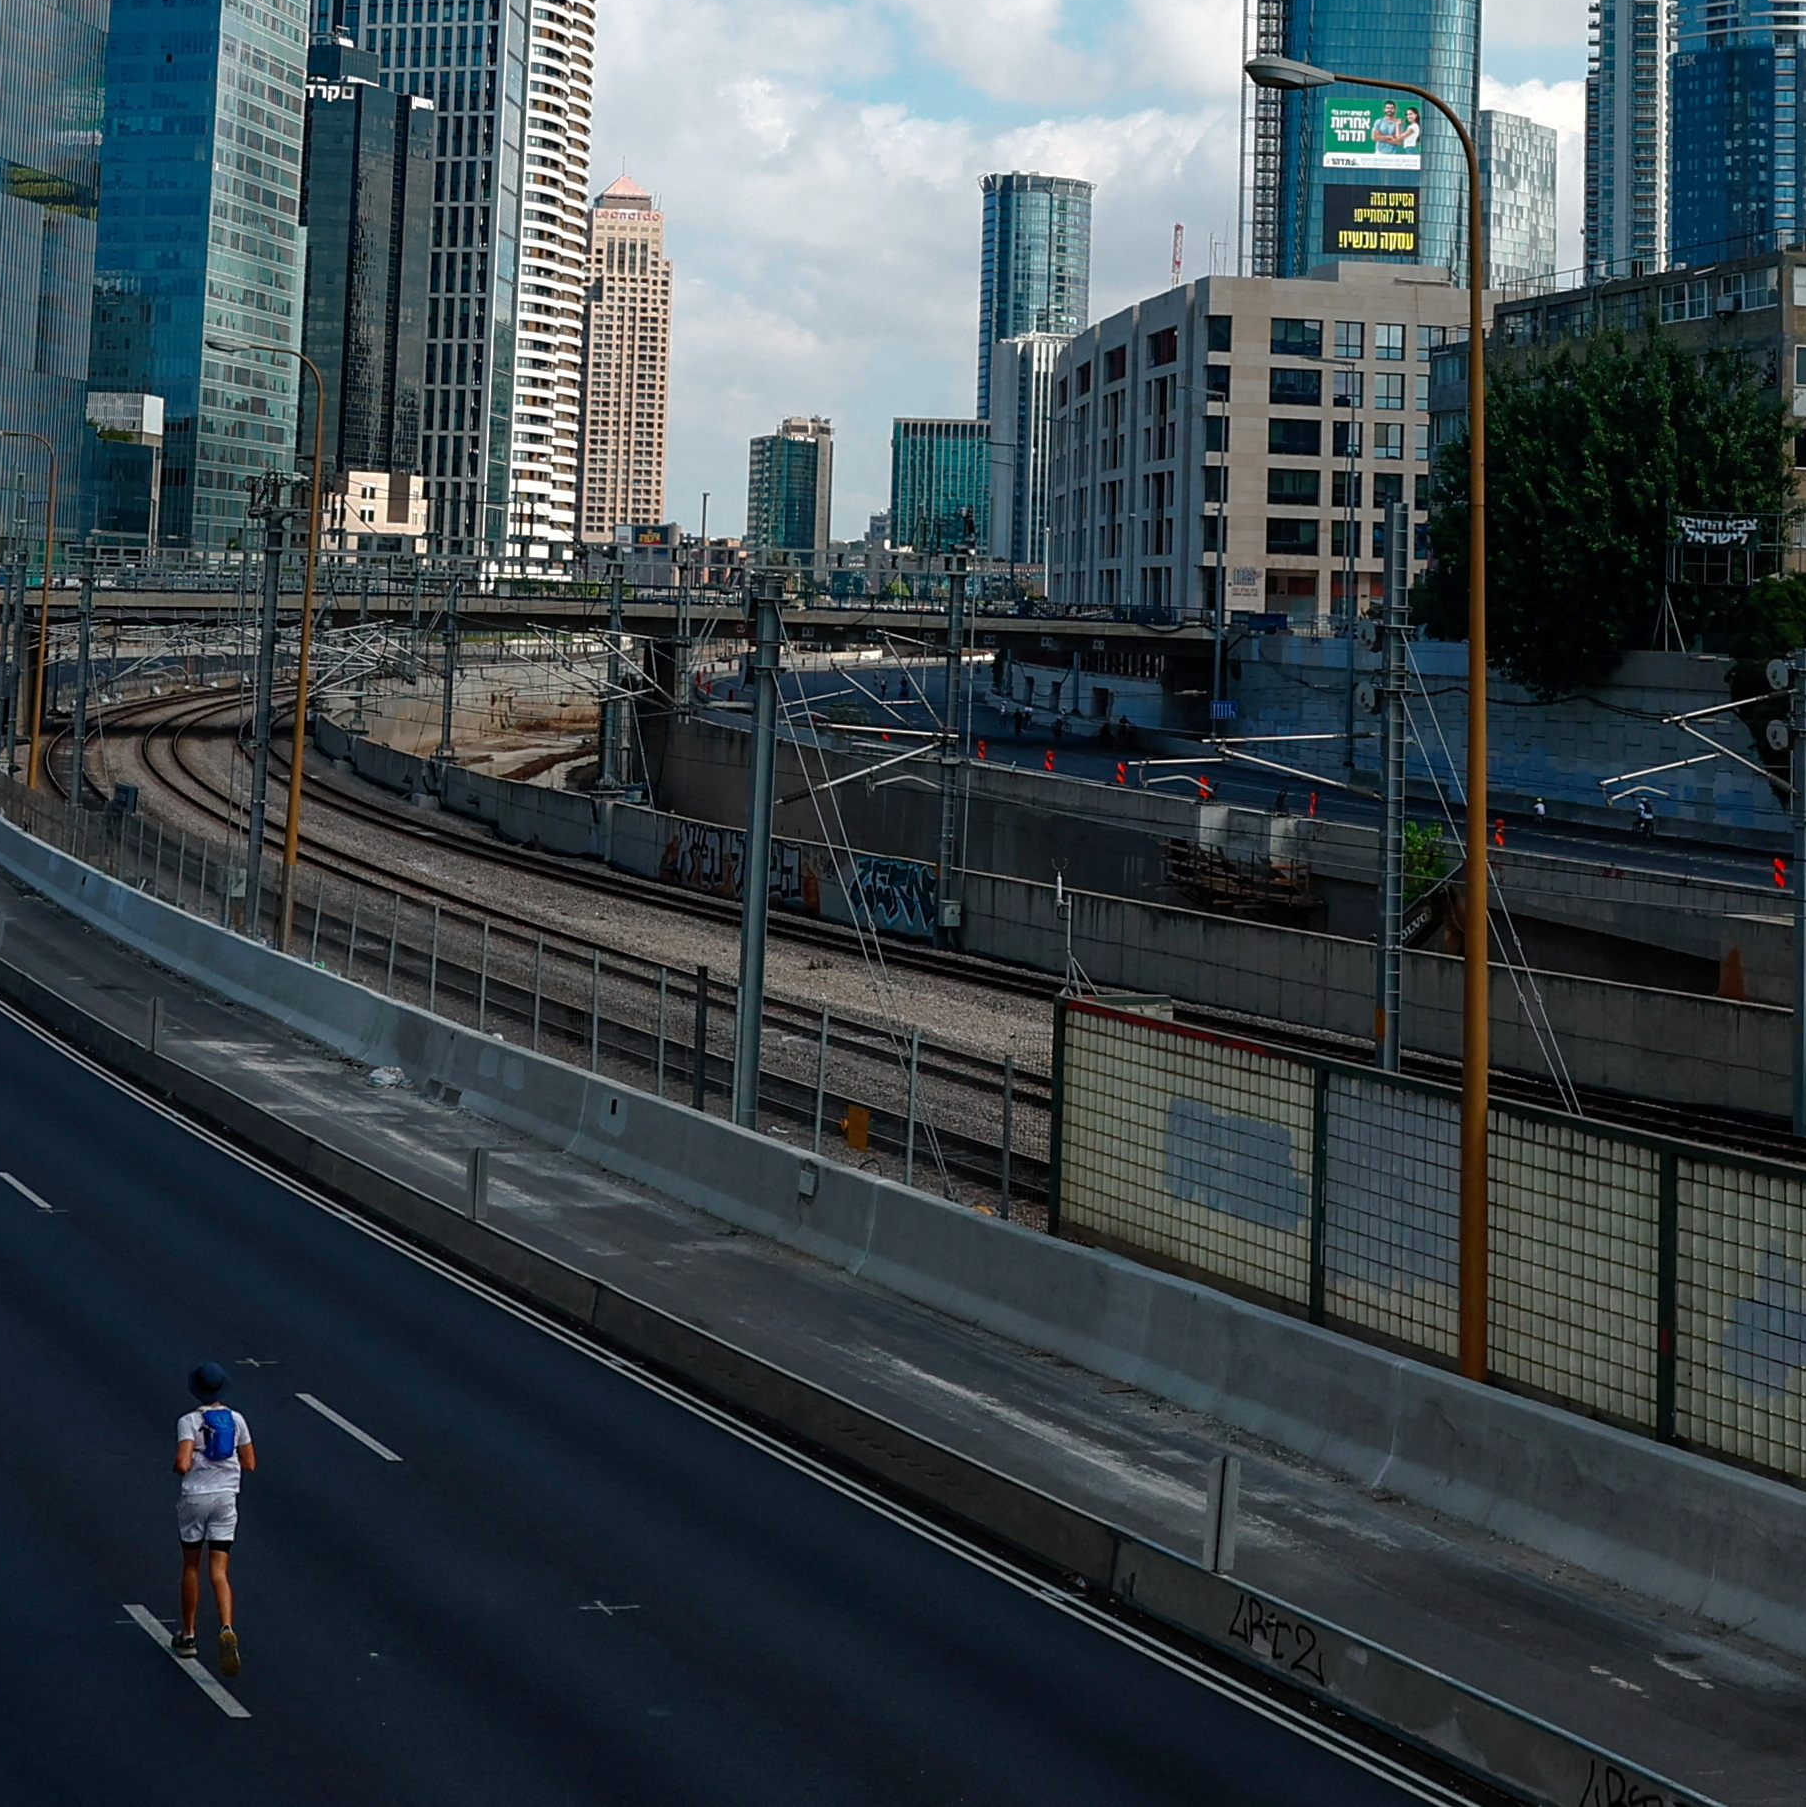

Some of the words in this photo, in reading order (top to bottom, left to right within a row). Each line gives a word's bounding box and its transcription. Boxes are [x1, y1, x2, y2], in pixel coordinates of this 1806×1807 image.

[1677, 55, 1696, 67] IBM
[305, 84, 340, 102] קרד
[1330, 116, 1371, 129] אחריות
[1334, 129, 1366, 142] תדהר
[1370, 192, 1387, 206] הזה
[1354, 208, 1394, 224] להסתיים!
[1396, 210, 1415, 224] חייב
[1338, 231, 1378, 250] עכשיו!
[1380, 232, 1414, 251] עסקה
[1725, 518, 1758, 530] צבא
[1685, 528, 1748, 545] לישראל
[1401, 912, 1427, 940] OLVO
